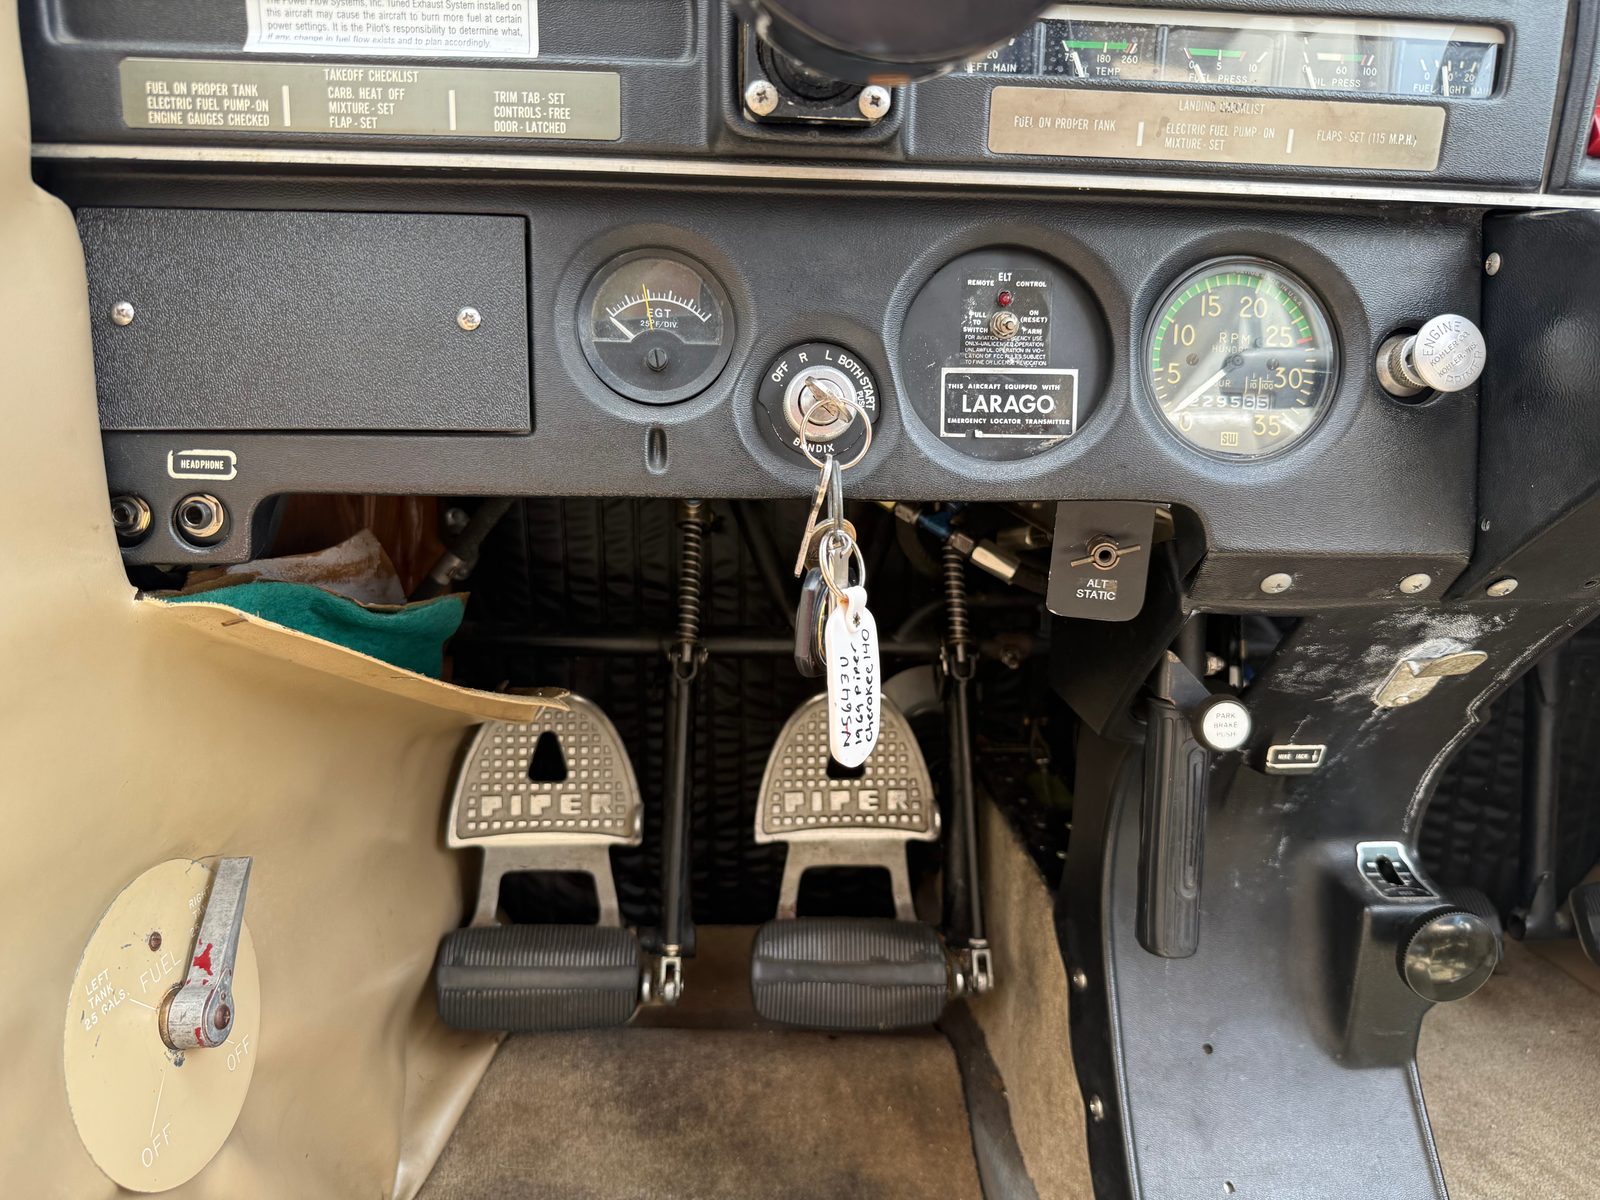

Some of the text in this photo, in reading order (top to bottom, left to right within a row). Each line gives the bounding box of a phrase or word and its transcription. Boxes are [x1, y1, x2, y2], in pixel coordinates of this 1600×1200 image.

[413, 0, 444, 9] Exhaust
[445, 1, 475, 12] System
[477, 1, 510, 11] installed
[266, 8, 522, 24] this aircraft may cause the aircraft to burn more fuel at certain
[267, 22, 523, 38] power settings. It is the Pilot's responsibility to determine what,
[294, 34, 324, 43] change
[336, 34, 351, 44] fuel
[353, 35, 370, 44] flow
[372, 37, 395, 45] exists
[397, 37, 413, 46] and
[415, 38, 423, 46] to
[425, 38, 442, 48] plan
[1097, 53, 1111, 64] 180
[1121, 55, 1138, 65] 260
[1188, 60, 1258, 73] 0 5 10
[323, 69, 419, 83] TAKEOFF CHECKLIST
[993, 63, 1017, 73] MAIN
[1095, 67, 1120, 77] TEMP
[1336, 66, 1377, 78] 60 100
[1218, 75, 1248, 84] PRESS
[1331, 79, 1361, 88] PRESS
[1464, 74, 1475, 83] 20
[146, 81, 258, 97] FUEL ON PROPER TANK
[327, 86, 406, 101] CARB. HEAT OFF
[1413, 83, 1436, 94] FUEL
[147, 96, 192, 110] ELECTRIC
[196, 97, 220, 111] FUEL
[493, 91, 518, 104] TRIM
[1178, 99, 1216, 112] LANDING
[148, 111, 270, 127] ENGINE GAUGES CHECKED
[1014, 115, 1116, 132] FUEL ON PROPER TANK
[1166, 122, 1206, 135] ELECTRIC
[1209, 124, 1229, 137] FUEL
[1263, 126, 1275, 139] ON
[967, 279, 995, 287] REMOTE
[998, 272, 1012, 283] ELT
[646, 308, 672, 319] EGT
[1201, 295, 1222, 318] 15
[1239, 296, 1268, 319] 20
[1020, 316, 1048, 324] (RESET)
[1173, 323, 1196, 346] 10
[1265, 326, 1293, 348] 25
[1422, 320, 1462, 356] ENGINE
[798, 352, 809, 363] R
[825, 350, 833, 361] L
[1430, 340, 1460, 367] KOHLER
[771, 361, 790, 382] OFF
[837, 354, 865, 380] BOTH
[1167, 362, 1182, 384] 5
[1274, 368, 1303, 389] 30
[859, 376, 876, 411] START
[962, 394, 1056, 414] LARAGO
[1179, 411, 1193, 432] 0
[1253, 414, 1281, 437] 35
[793, 437, 835, 453] BNDIX
[180, 459, 224, 470] HEADPHONE
[1086, 578, 1109, 589] ALT
[1076, 588, 1116, 601] STATIC
[861, 629, 871, 660] 140
[840, 656, 853, 747] N5643U
[481, 793, 612, 817] PIPER
[784, 789, 910, 813] PIPER
[139, 950, 182, 994] FUEL
[85, 968, 109, 996] LEFT
[88, 982, 114, 1009] TANK
[84, 1011, 98, 1032] 25
[227, 1034, 250, 1072] OFF
[141, 1123, 172, 1168] OFF
